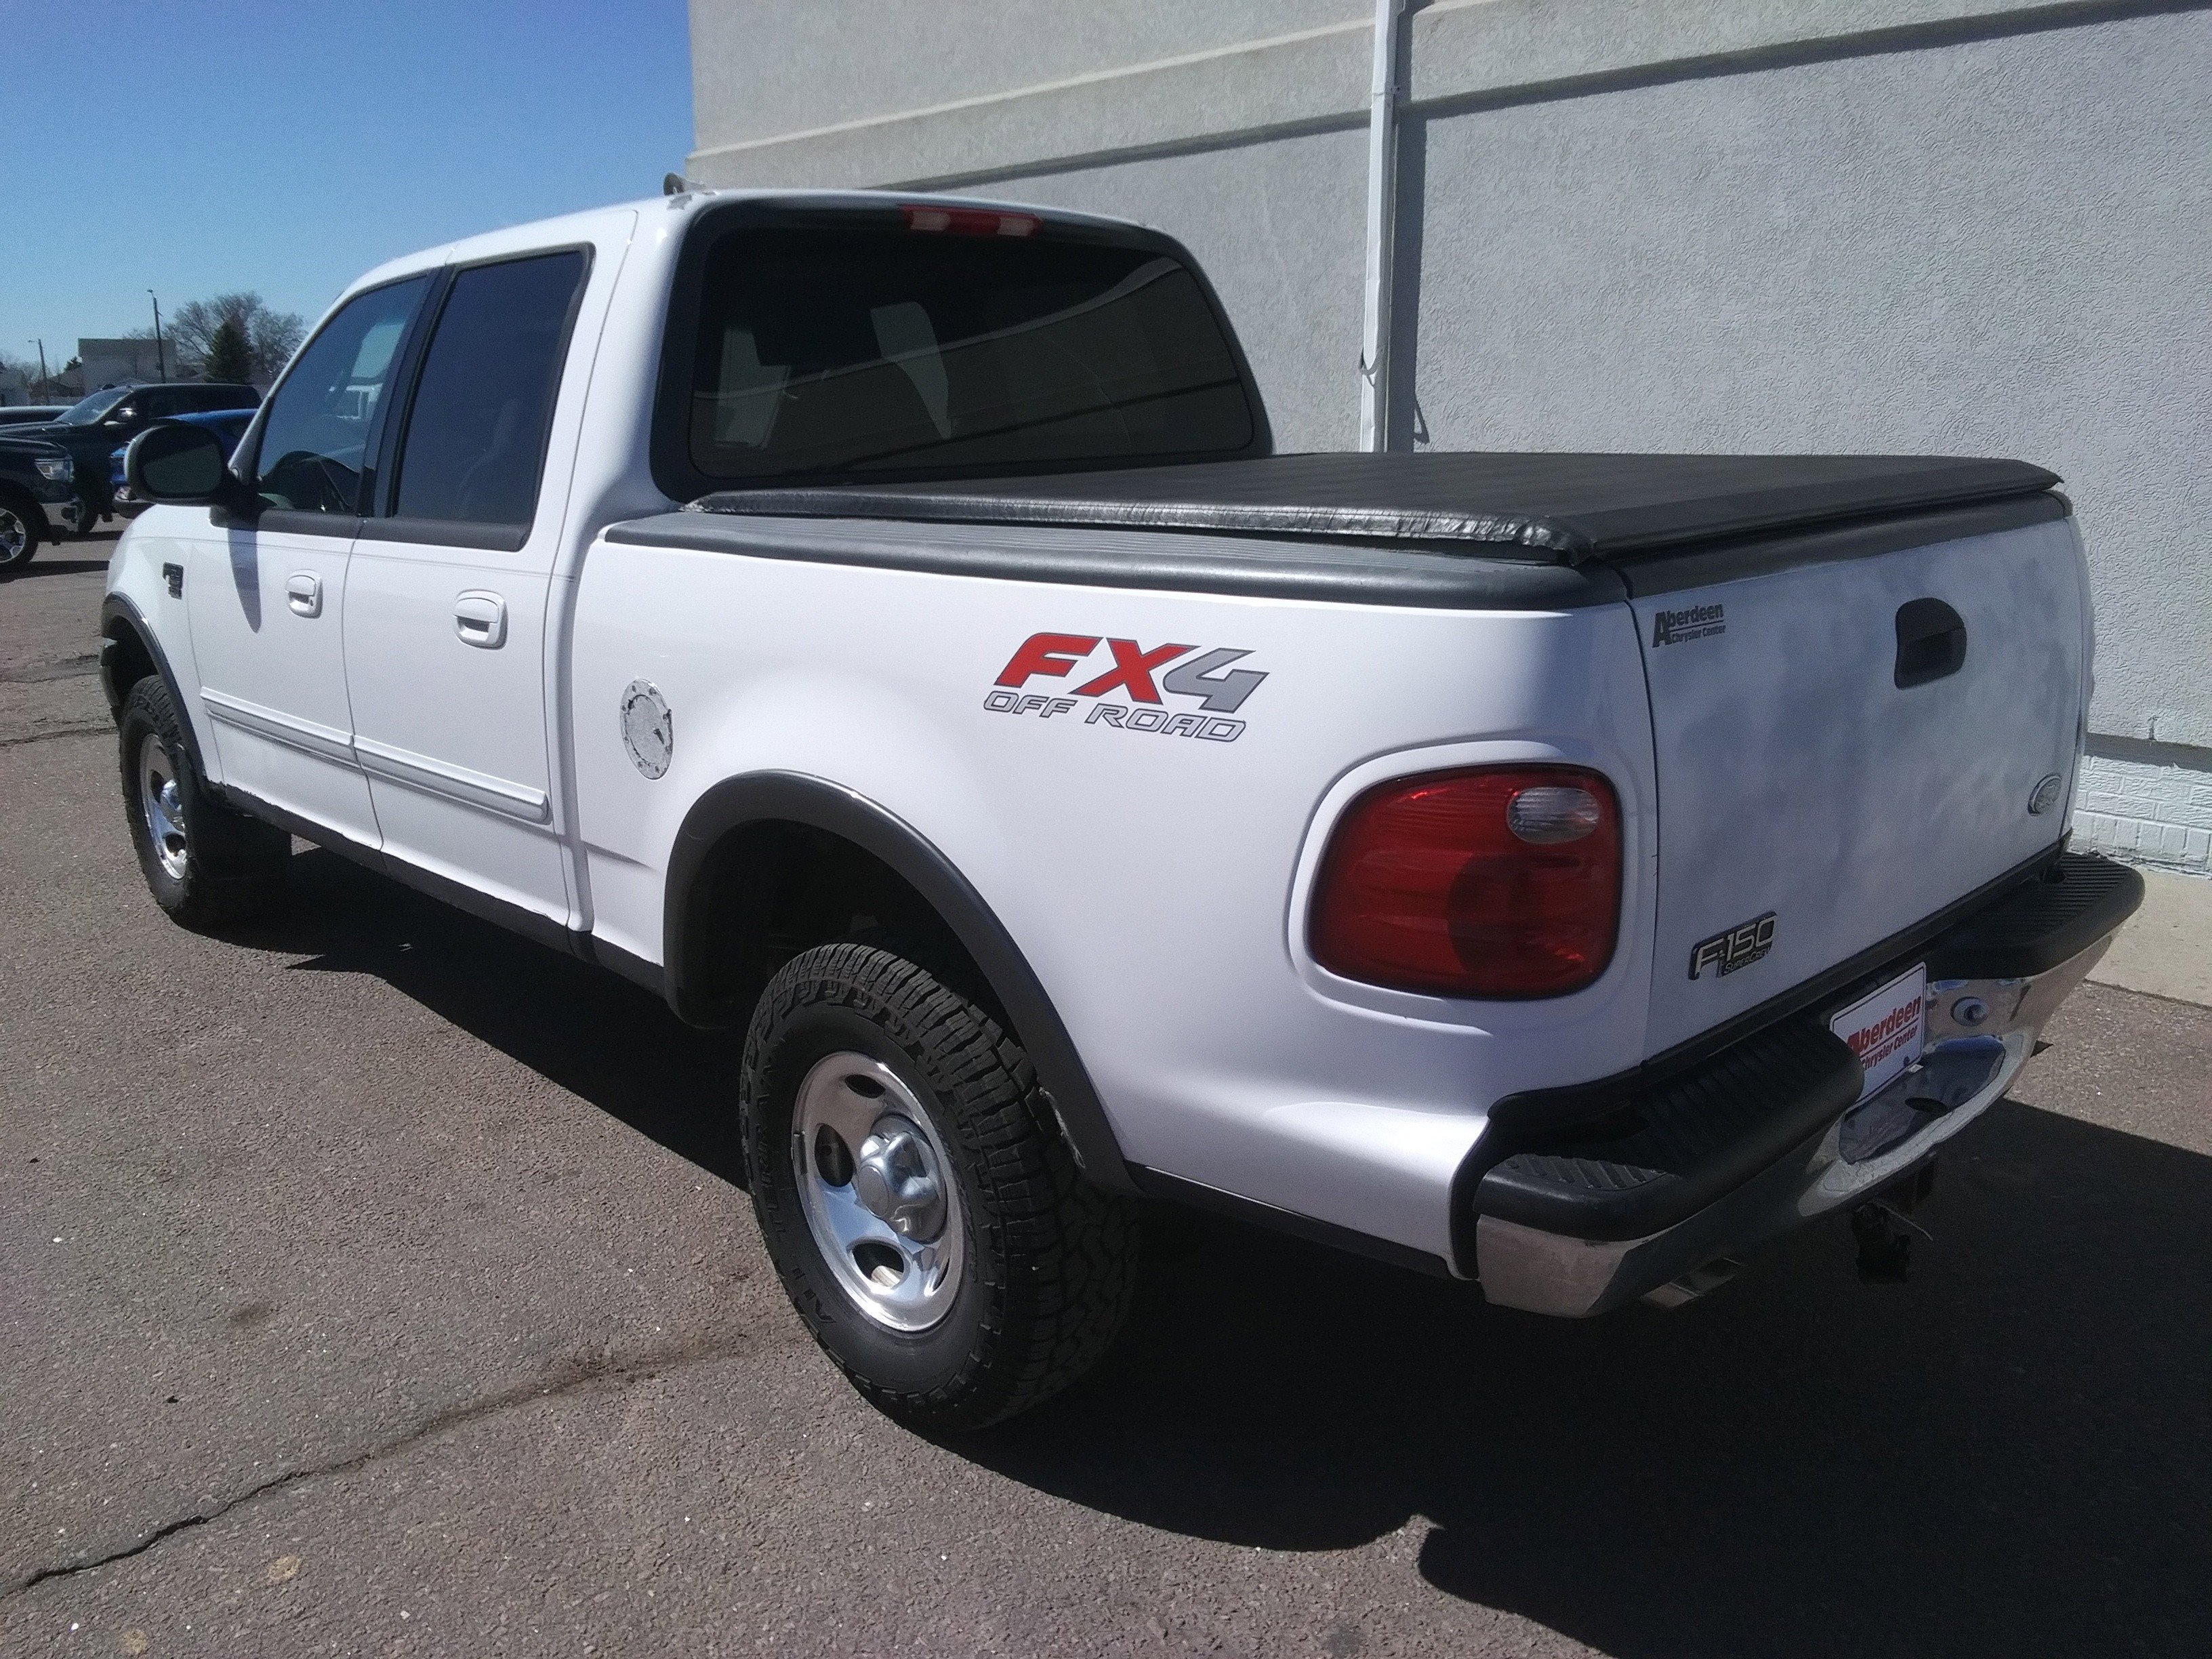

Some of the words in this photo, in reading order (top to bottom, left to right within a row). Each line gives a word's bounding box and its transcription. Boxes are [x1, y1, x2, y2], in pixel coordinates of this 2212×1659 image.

[1652, 604, 1724, 648] Aberdeen
[1672, 629, 1702, 643] Chrysler
[1702, 625, 1726, 637] Center
[994, 632, 1270, 714] FX4
[983, 691, 1078, 718] OFF
[1084, 703, 1247, 743] ROAD
[1893, 1025, 1918, 1050] Center
